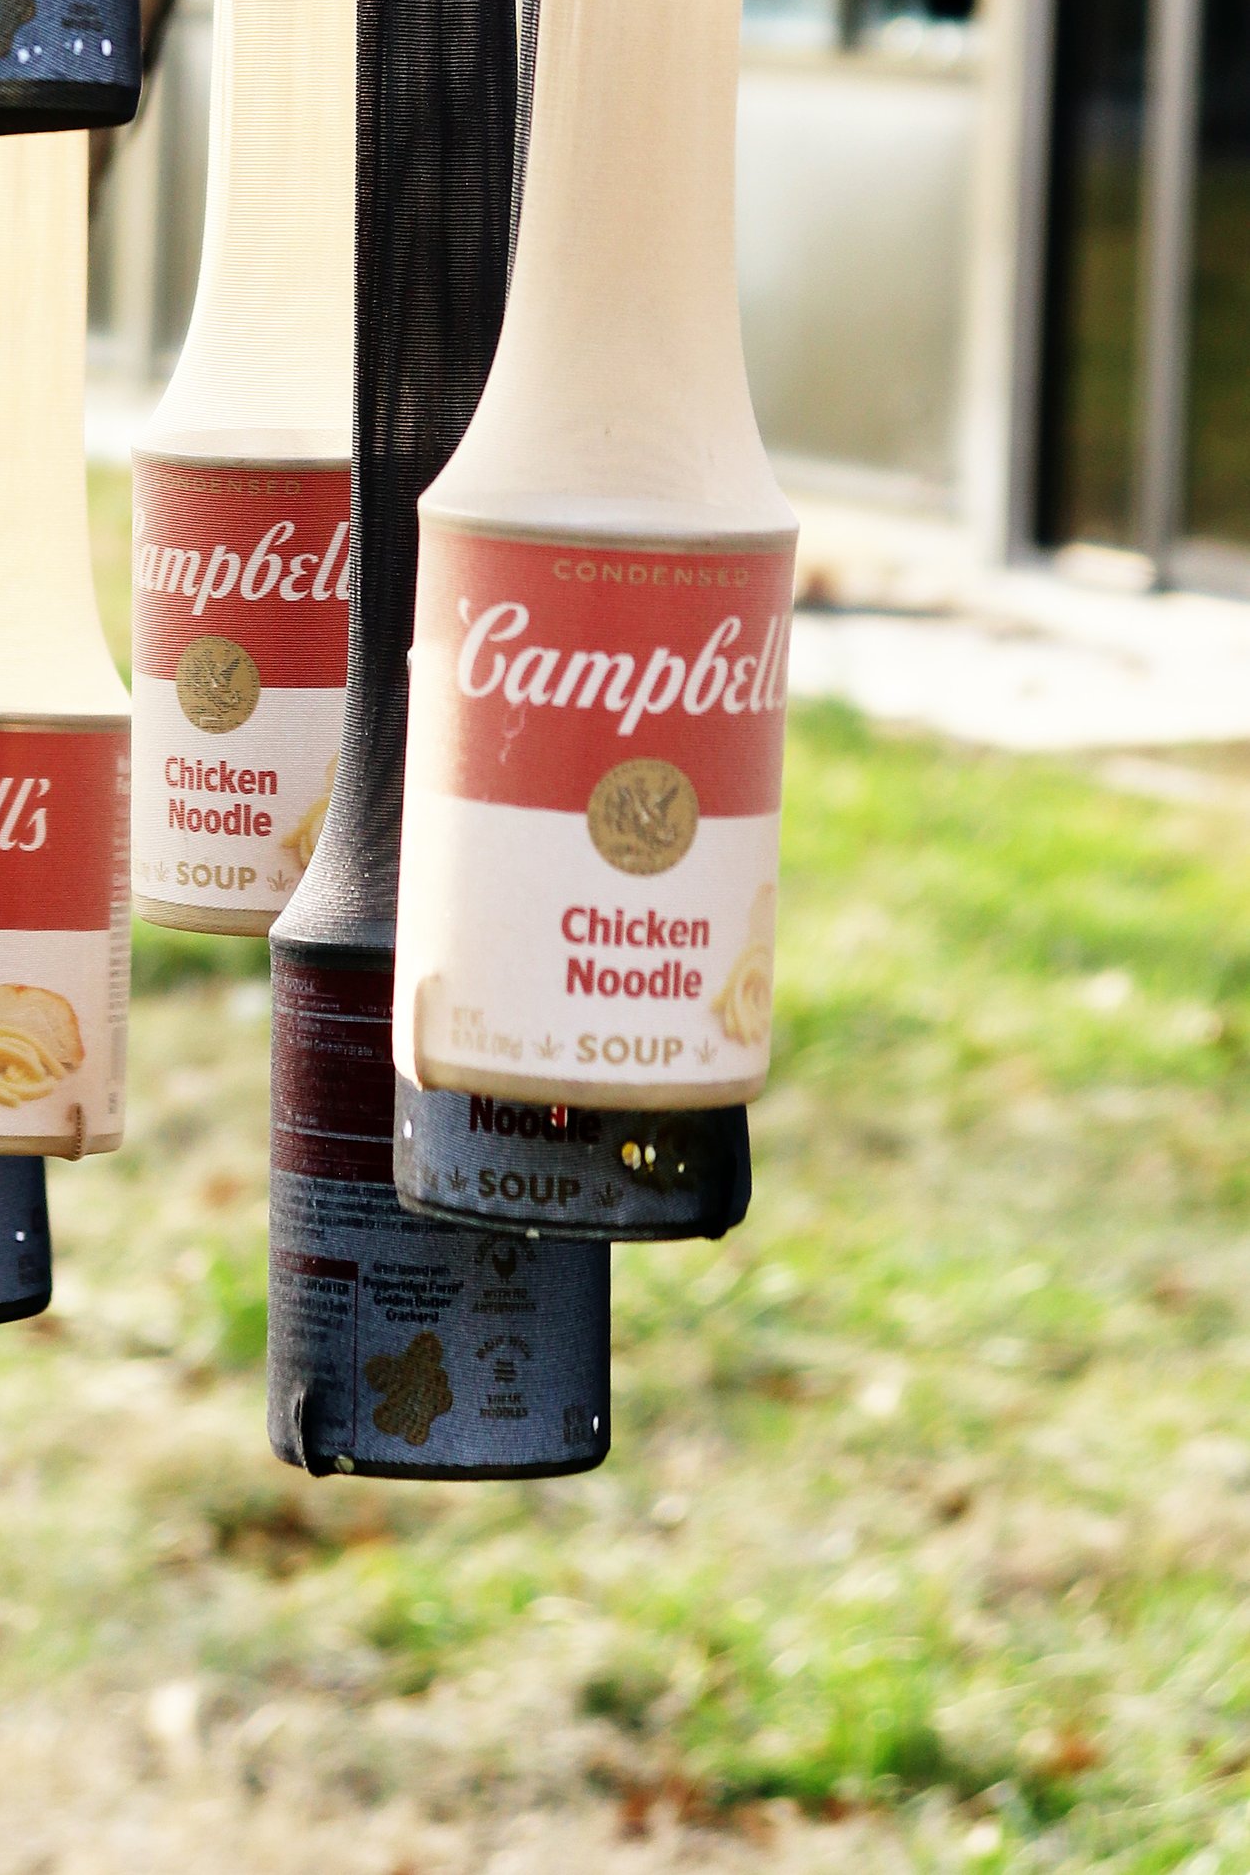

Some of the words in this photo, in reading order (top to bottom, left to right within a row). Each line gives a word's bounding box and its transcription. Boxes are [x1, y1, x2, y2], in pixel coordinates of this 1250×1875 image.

[551, 558, 751, 588] CONDENSED
[457, 597, 792, 738] Campbell
[164, 755, 278, 796] Chicken
[168, 798, 273, 838] Noodle
[176, 860, 258, 891] SOUP
[560, 906, 711, 950] Chicken
[565, 957, 704, 1001] Noodle
[576, 1033, 685, 1067] SOUP
[469, 1093, 603, 1145] Noodle
[478, 1167, 582, 1207] SOUP
